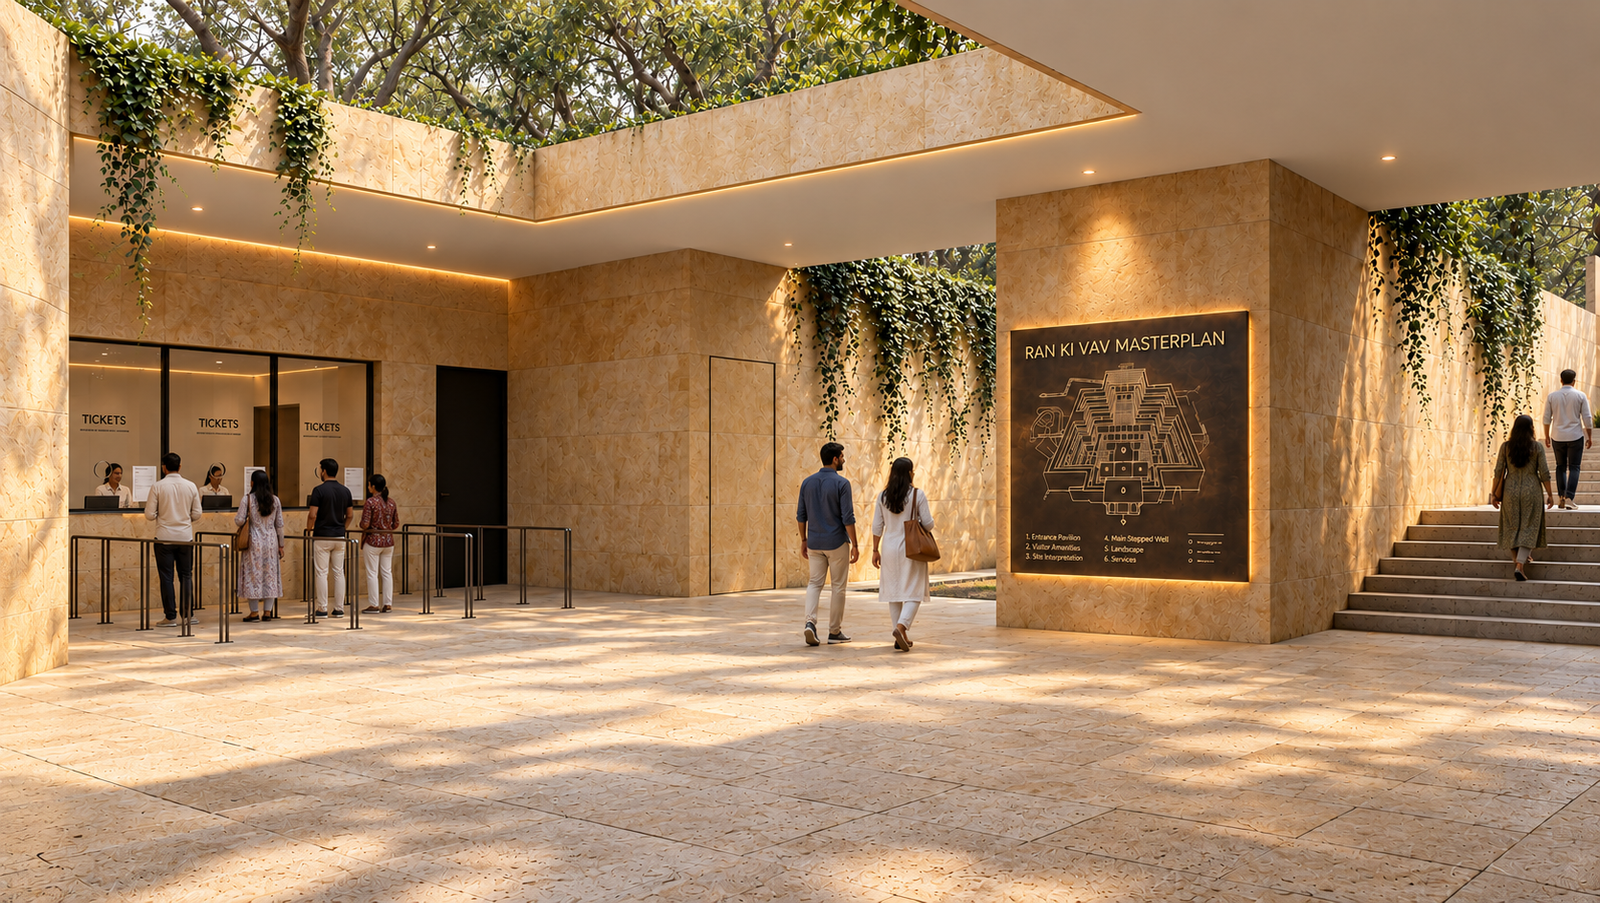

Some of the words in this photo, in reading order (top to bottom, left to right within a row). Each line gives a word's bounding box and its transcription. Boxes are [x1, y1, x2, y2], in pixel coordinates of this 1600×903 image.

[1025, 344, 1055, 359] RAN
[1060, 342, 1074, 357] KI
[1079, 339, 1110, 355] VAV
[1115, 330, 1225, 353] MASTERPLAN
[82, 414, 126, 425] TICKETS
[199, 418, 239, 429] TICKETS
[304, 422, 340, 432] TICKETS
[1031, 533, 1057, 541] Entrance
[1058, 533, 1081, 541] Pavilion
[1051, 543, 1080, 551] Amenities
[1111, 545, 1144, 554] Landscape
[1044, 553, 1083, 562] Interpretation
[1111, 555, 1137, 563] Services
